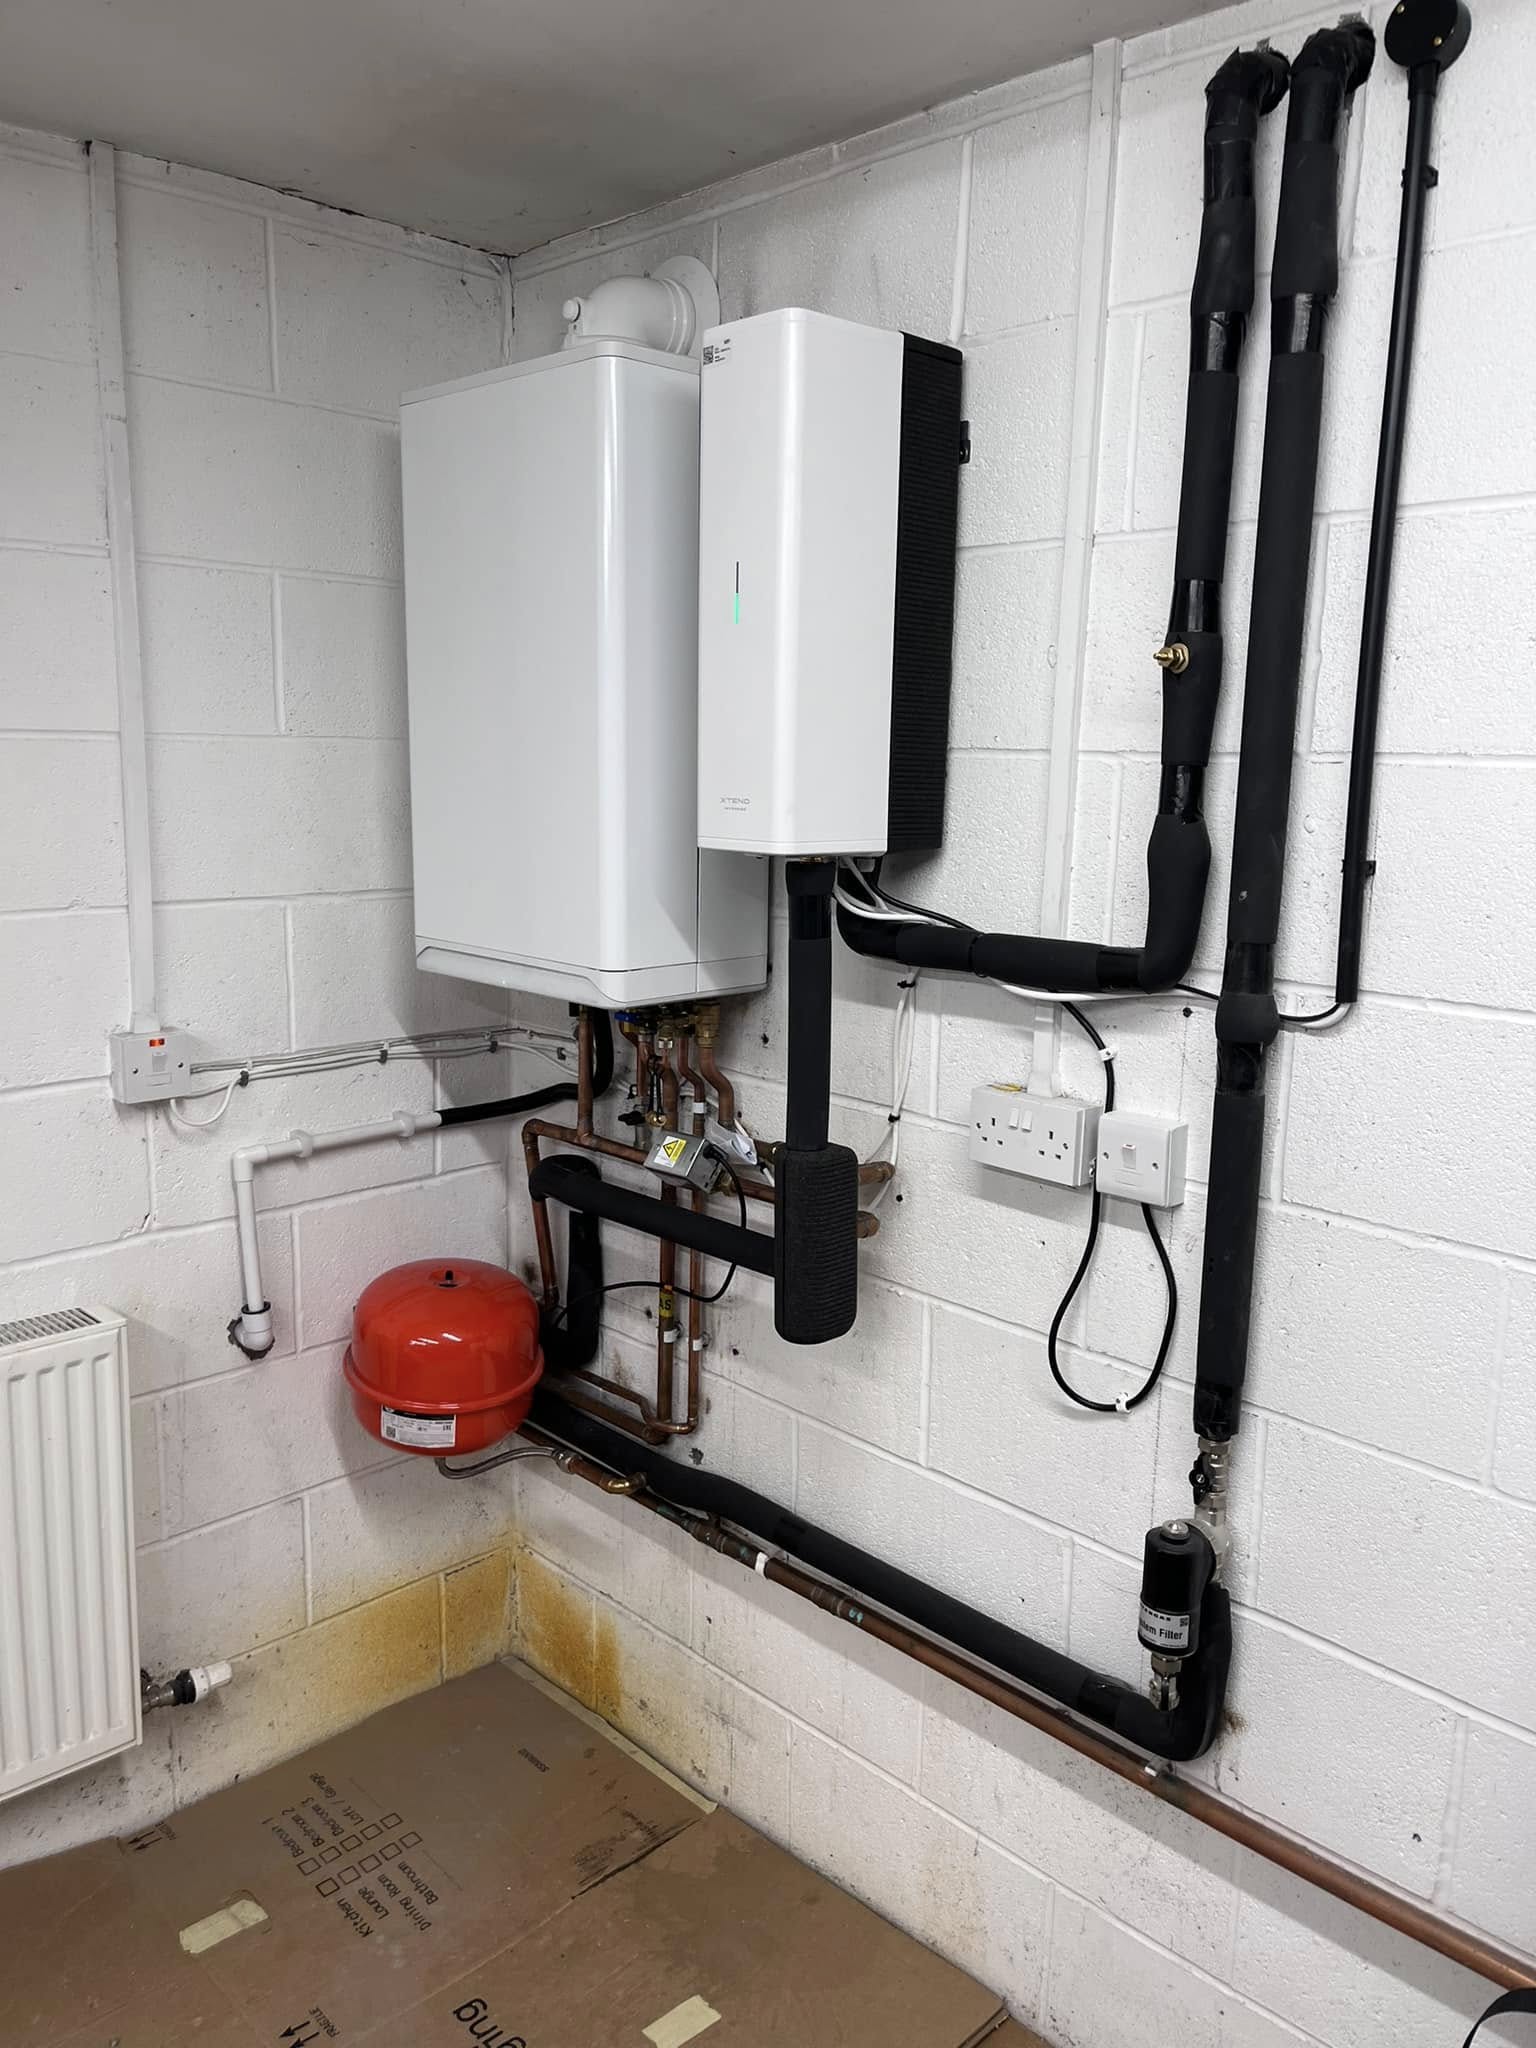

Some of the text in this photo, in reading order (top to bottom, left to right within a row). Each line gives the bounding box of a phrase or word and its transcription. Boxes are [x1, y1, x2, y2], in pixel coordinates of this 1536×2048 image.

[659, 1297, 672, 1310] AS
[1159, 1628, 1183, 1640] Filter
[281, 1807, 295, 1816] 2
[301, 1797, 314, 1805] 3
[343, 1805, 365, 1826] Loft
[398, 1862, 440, 1905] Bathroom
[358, 1886, 390, 1920] Lounge
[377, 1873, 433, 1931] Dining Room
[336, 1897, 375, 1938] Kitchen
[308, 2004, 341, 2038] FRAGILE
